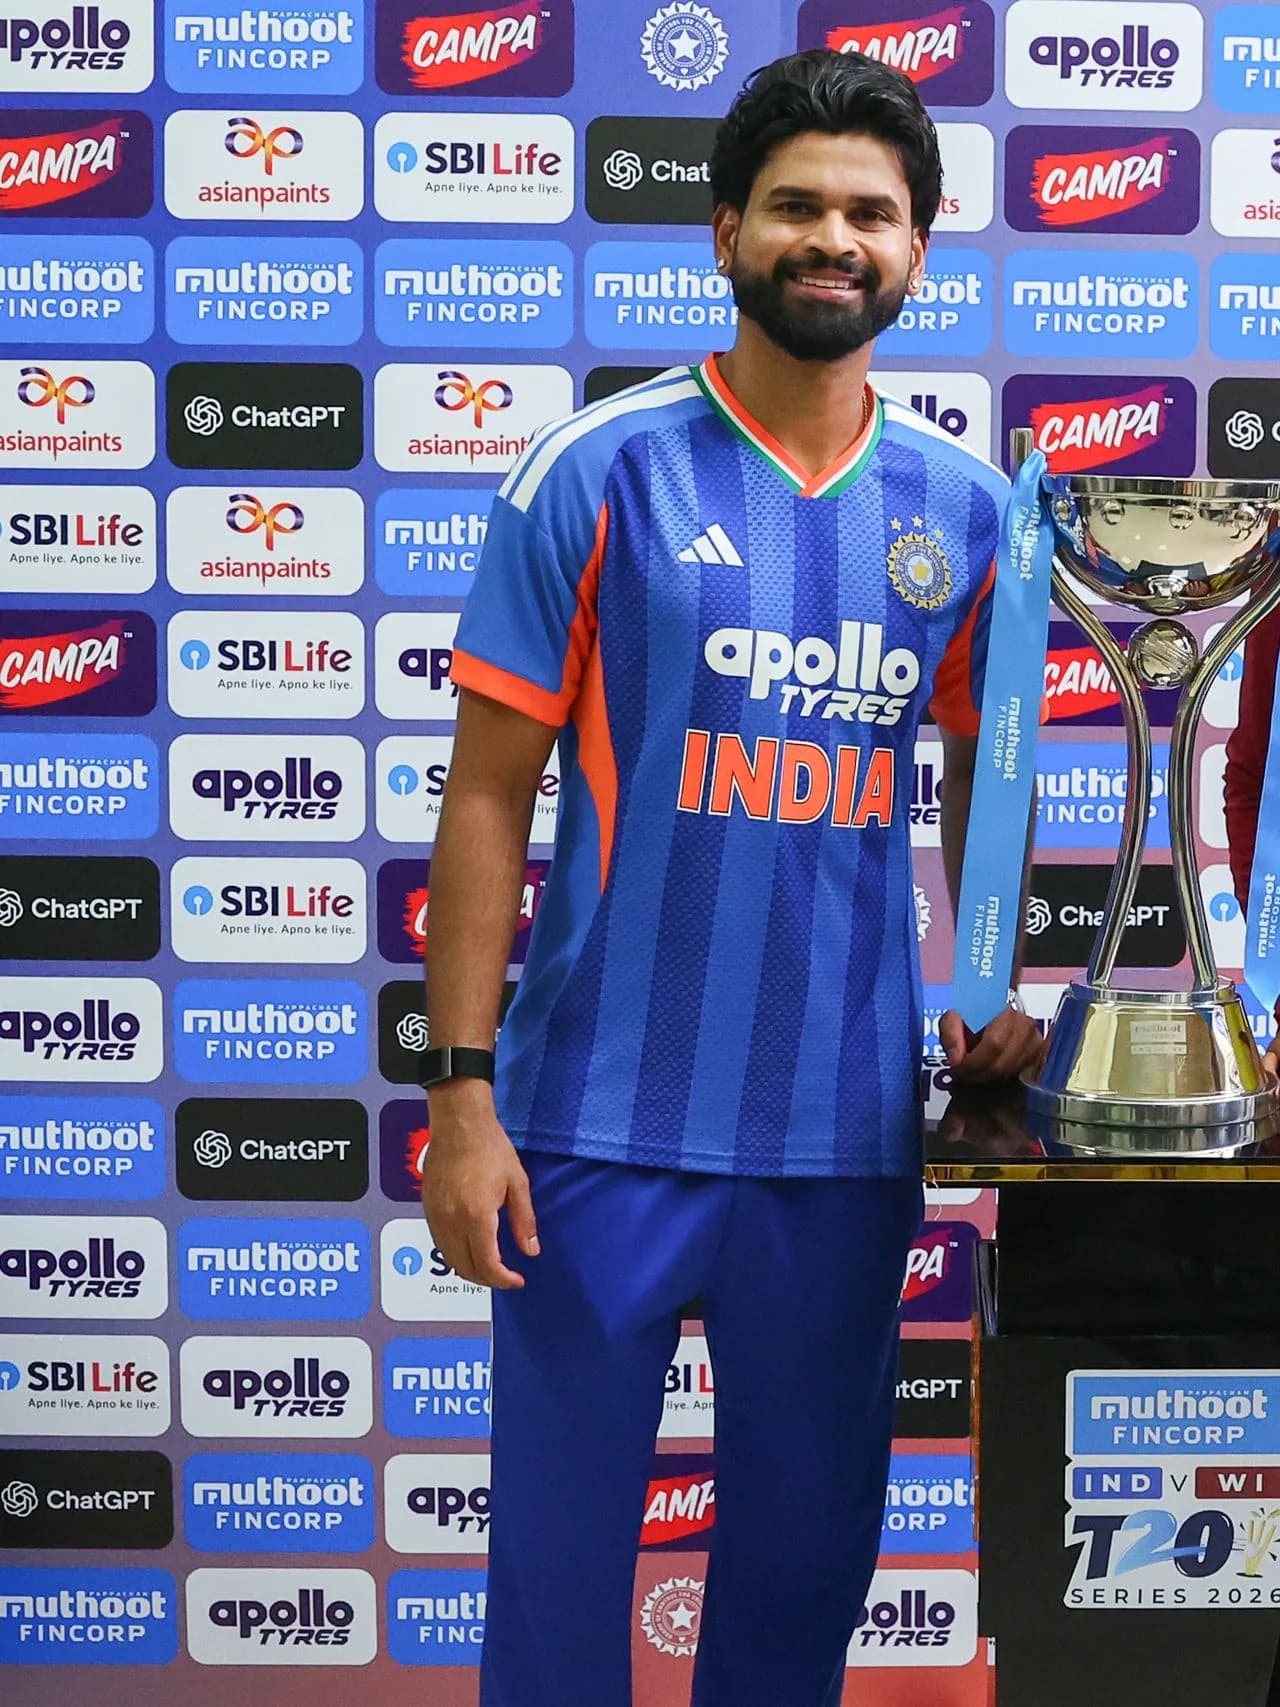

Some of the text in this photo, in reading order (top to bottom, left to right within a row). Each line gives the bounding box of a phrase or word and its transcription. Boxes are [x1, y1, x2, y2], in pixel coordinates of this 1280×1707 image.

[176, 11, 353, 42] muthoot
[413, 15, 536, 67] CAMPA
[31, 51, 126, 69] TYRES
[199, 49, 329, 68] FINCORP
[1029, 25, 1179, 80] apollo
[1081, 69, 1174, 88] TYRES
[0, 135, 115, 188] CAMPA
[426, 142, 561, 175] SBI Life
[425, 182, 454, 193] Apne
[487, 183, 517, 193] Apno
[522, 184, 534, 192] ke
[1042, 153, 1163, 204] CAMPA
[199, 181, 329, 212] asianpaints
[385, 265, 562, 296] muthoot
[1014, 276, 1188, 308] muthoot
[409, 303, 539, 322] FINCORP
[1036, 313, 1165, 333] FINCORP
[232, 406, 345, 427] ChatGPT
[1039, 402, 1159, 452] CAMPA
[10, 514, 143, 546] SBI Life
[201, 557, 330, 586] asianpaints
[0, 636, 119, 687] CAMPA
[218, 640, 352, 672] SBI Life
[705, 620, 919, 699] apollo
[218, 679, 247, 689] Apne
[279, 680, 308, 690] Apno
[313, 680, 325, 689] ke
[780, 684, 909, 725] TYRES
[993, 705, 1007, 768] FINCORP
[1003, 697, 1021, 781] muthoot
[193, 758, 342, 811] apollo
[677, 729, 894, 828] INDIA
[244, 801, 338, 819] TYRES
[32, 898, 142, 919] ChatGPT
[221, 886, 353, 917] SBI Life
[1257, 873, 1277, 958] muthoot
[971, 904, 985, 966] FINCORP
[979, 896, 1000, 978] muthoot
[0, 1000, 140, 1053] apollo
[44, 1042, 136, 1060] TYRES
[240, 1140, 350, 1160] ChatGPT
[188, 1242, 359, 1271] muthoot
[211, 1278, 337, 1296] FINCORP
[28, 1362, 158, 1392] SBI Life
[203, 1358, 349, 1411] apollo
[254, 1400, 346, 1416] TYRES
[1091, 1390, 1267, 1419] muthoot
[1114, 1426, 1244, 1444] FINCORP
[194, 1477, 363, 1506] muthoot
[1086, 1474, 1262, 1492] IND V WI
[47, 1490, 155, 1509] ChatGPT
[217, 1512, 342, 1529] FINCORP
[1072, 1510, 1234, 1580] T20
[0, 1591, 166, 1618] muthoot
[1072, 1589, 1186, 1603] SERIES
[209, 1589, 354, 1643] apollo
[21, 1625, 145, 1641] FINCORP
[259, 1629, 350, 1645] TYRES
[861, 1630, 950, 1646] TYRES
